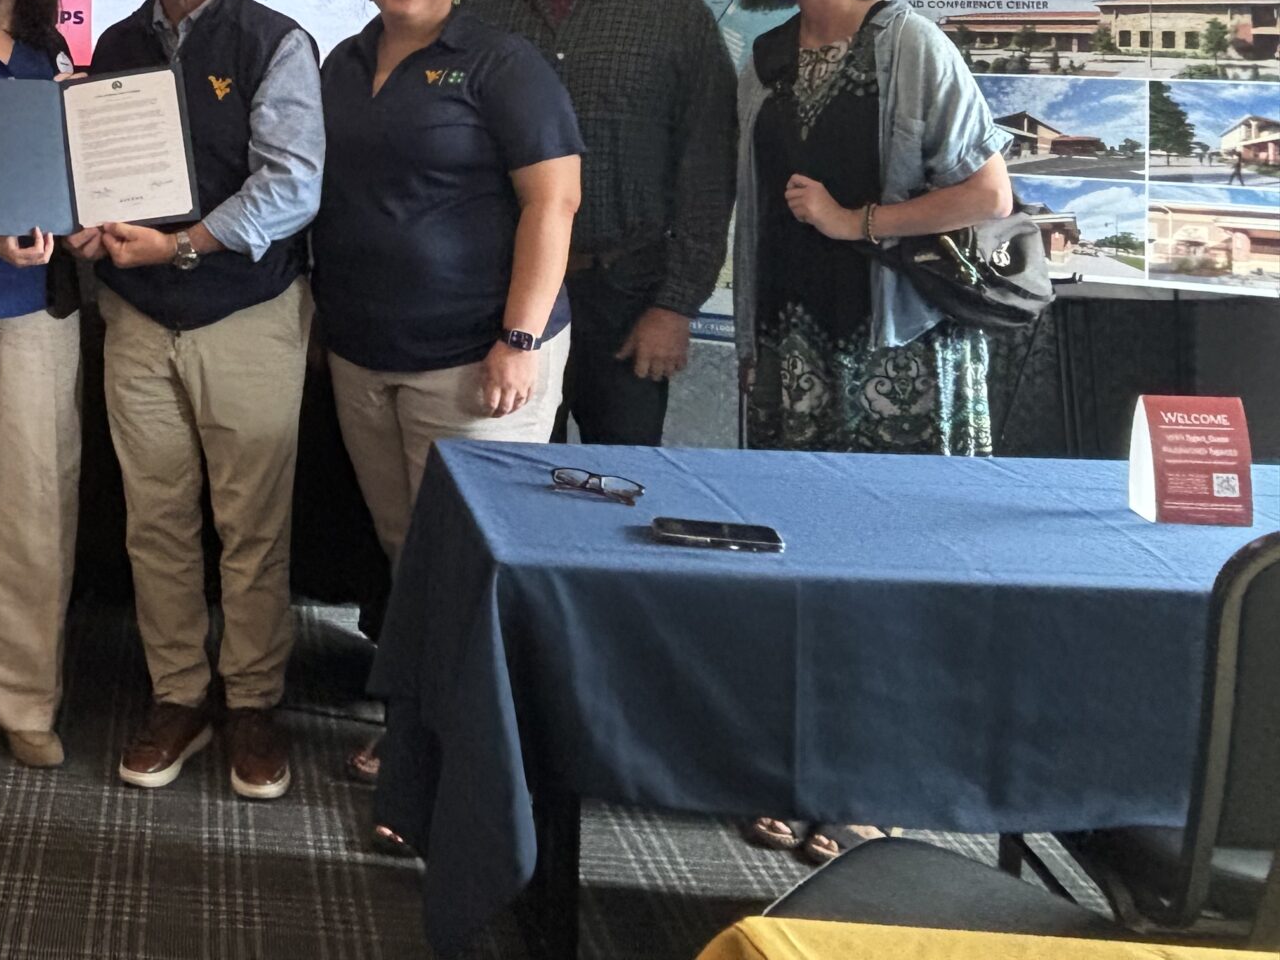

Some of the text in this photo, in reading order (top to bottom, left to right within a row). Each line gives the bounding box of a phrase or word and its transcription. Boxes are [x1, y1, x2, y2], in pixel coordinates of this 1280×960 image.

[908, 0, 1049, 10] ND CONFERENCE CENTER
[1159, 410, 1231, 426] WELCOME
